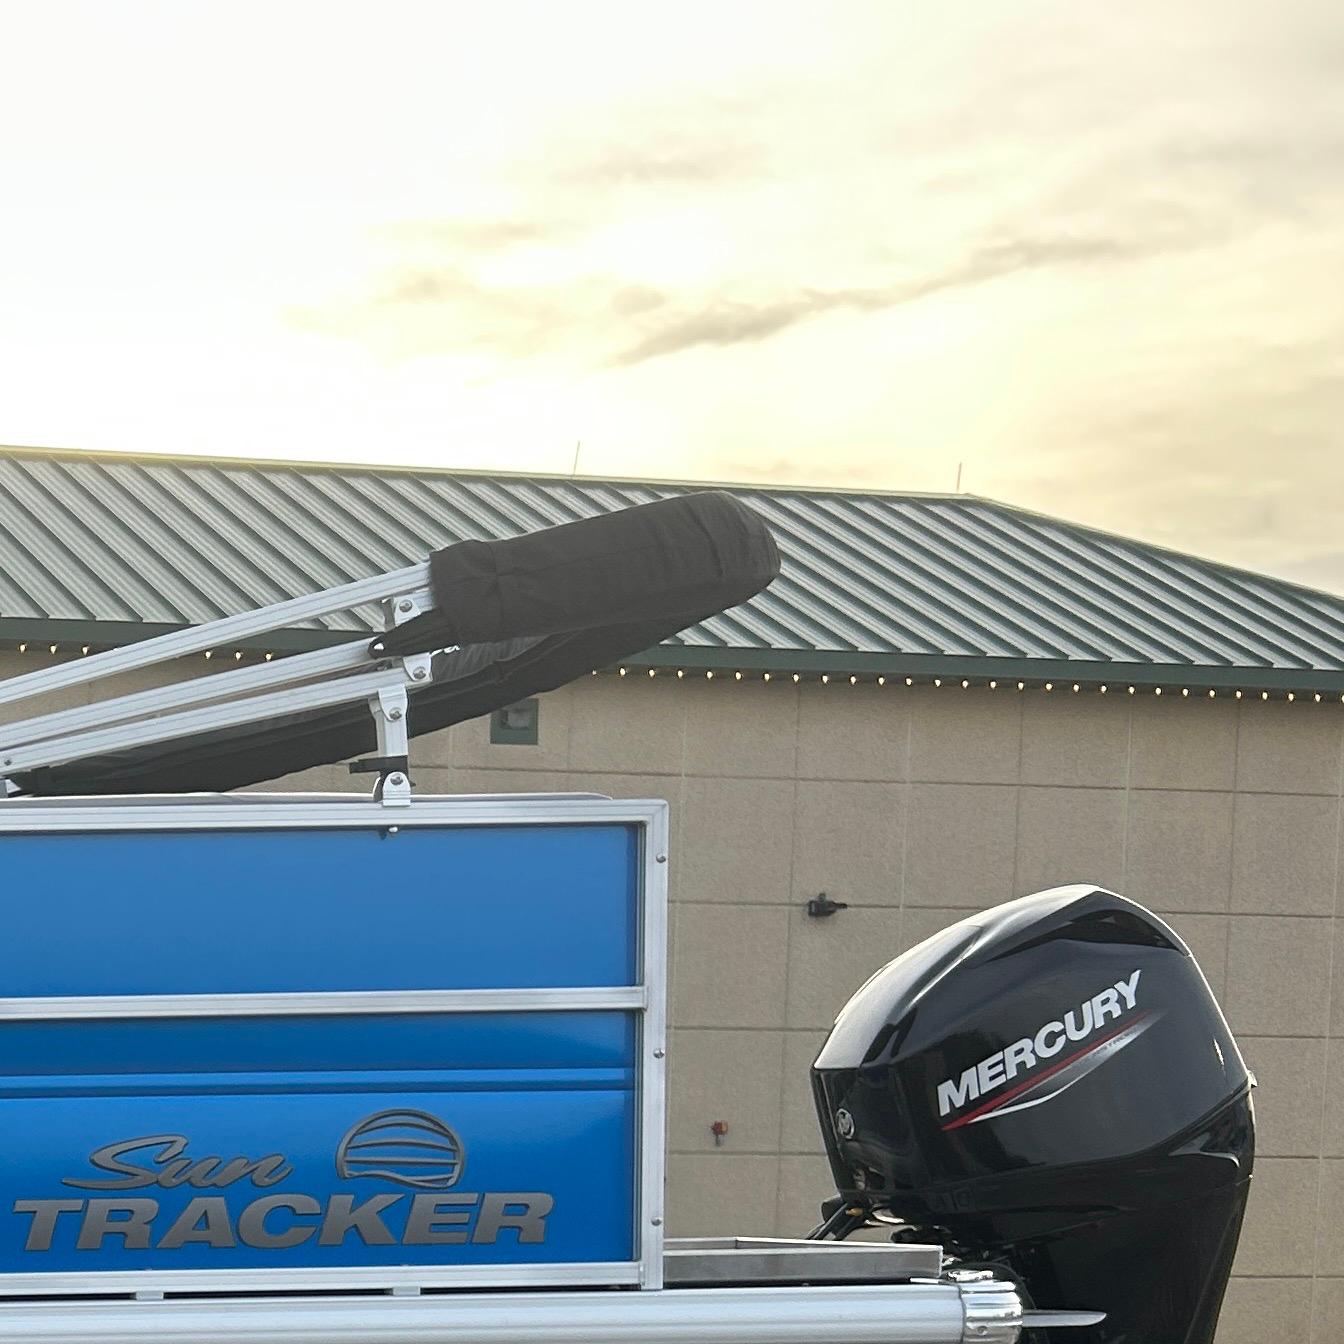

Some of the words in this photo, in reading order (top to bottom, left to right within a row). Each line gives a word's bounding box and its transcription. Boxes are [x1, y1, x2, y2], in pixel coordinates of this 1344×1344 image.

[936, 969, 1141, 1117] MERCURY
[61, 1133, 294, 1191] Sun
[13, 1191, 555, 1252] TRACKER
